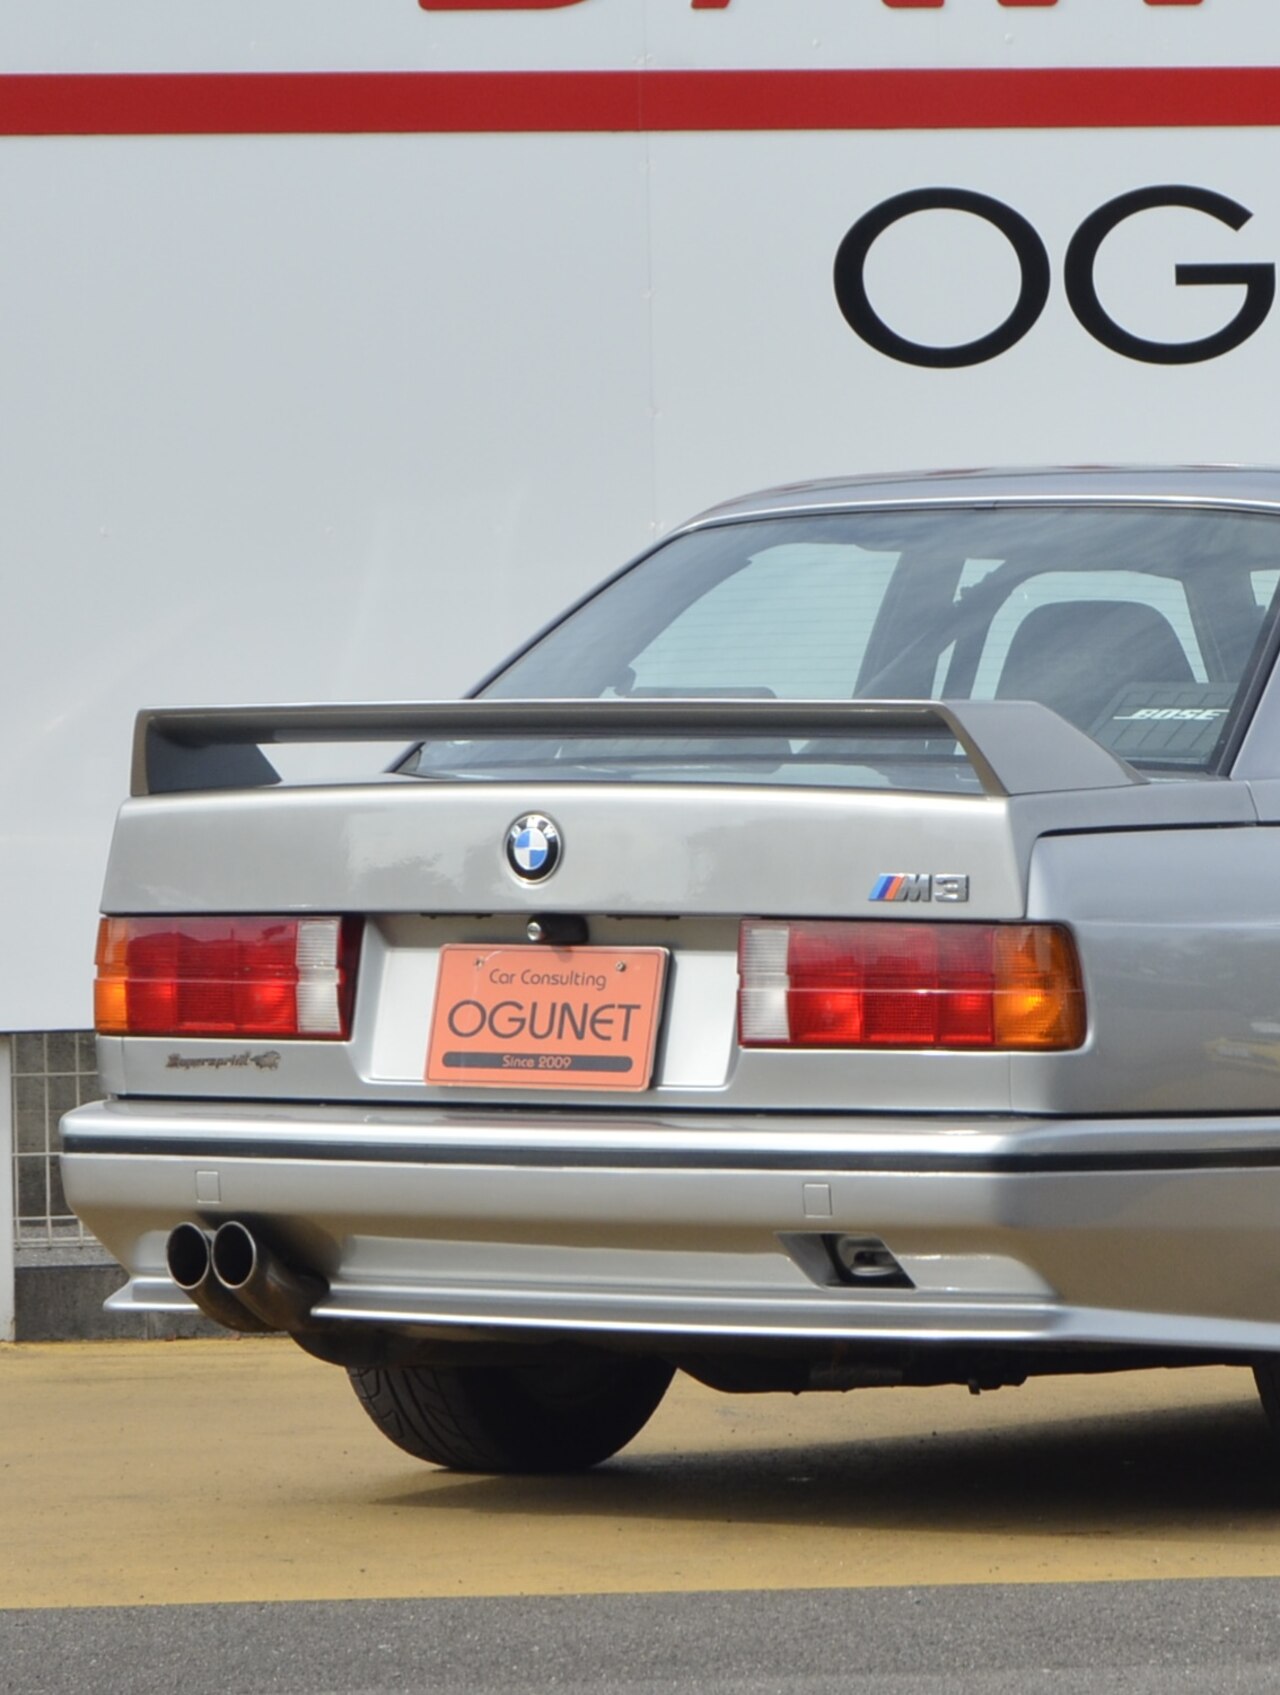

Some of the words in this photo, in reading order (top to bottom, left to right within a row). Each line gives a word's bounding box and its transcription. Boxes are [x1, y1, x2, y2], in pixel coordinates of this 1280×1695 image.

[1113, 708, 1229, 720] BOSE
[510, 814, 557, 838] BMW
[892, 873, 970, 902] M3
[489, 968, 516, 985] Car
[520, 969, 607, 991] Consulting
[447, 999, 641, 1042] OGUNET
[502, 1054, 534, 1068] Since
[538, 1055, 572, 1069] 2009
